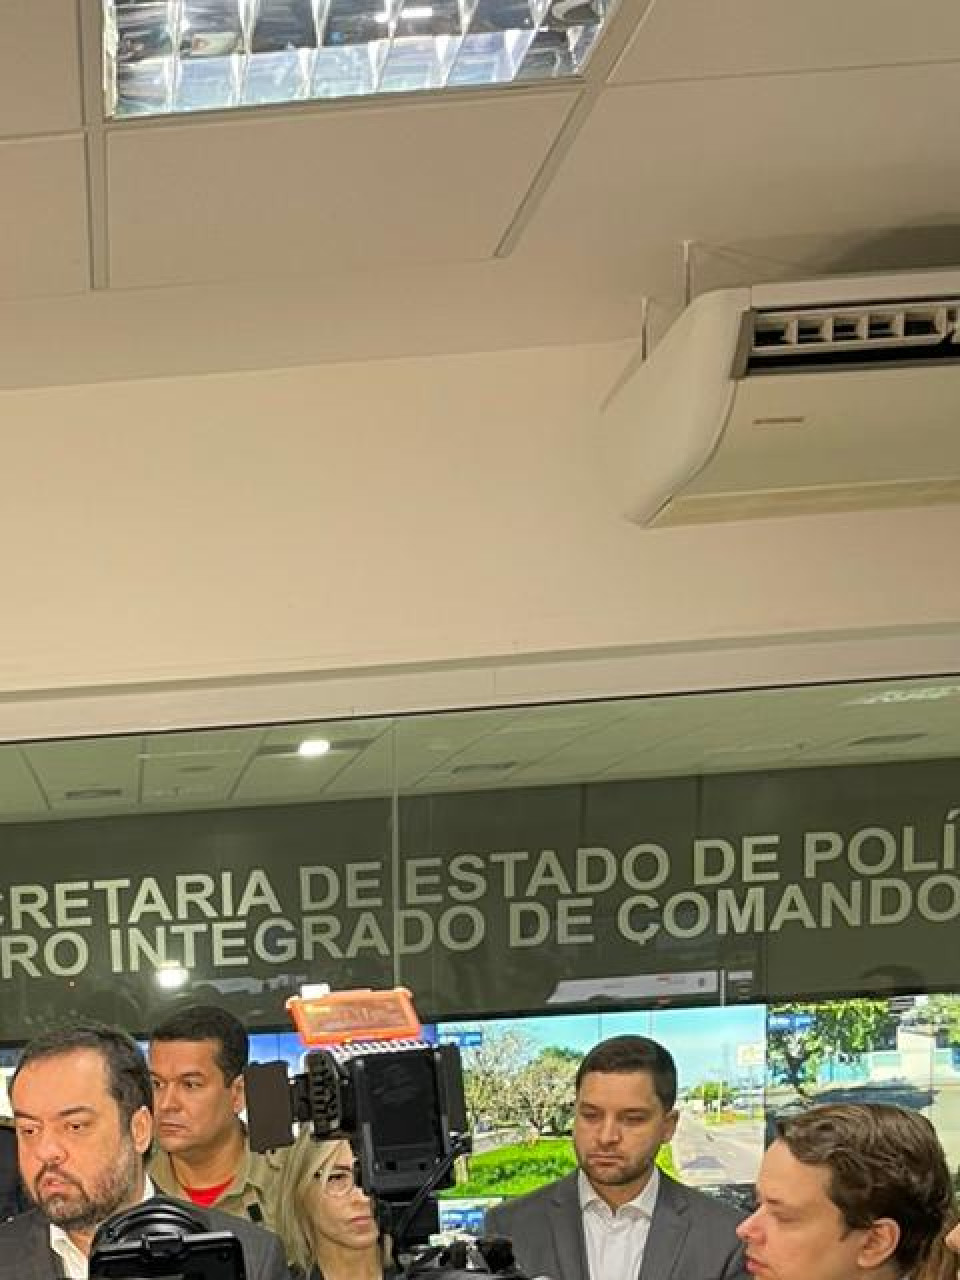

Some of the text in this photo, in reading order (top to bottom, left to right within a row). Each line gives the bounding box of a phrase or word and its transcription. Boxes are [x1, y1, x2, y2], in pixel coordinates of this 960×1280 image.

[299, 861, 383, 911] DE
[405, 844, 670, 904] ESTADO
[693, 835, 780, 886] DE
[803, 808, 960, 879] POLÍ
[109, 903, 486, 973] INTEGRADO
[509, 897, 595, 947] DE
[617, 874, 960, 945] COMANDO
